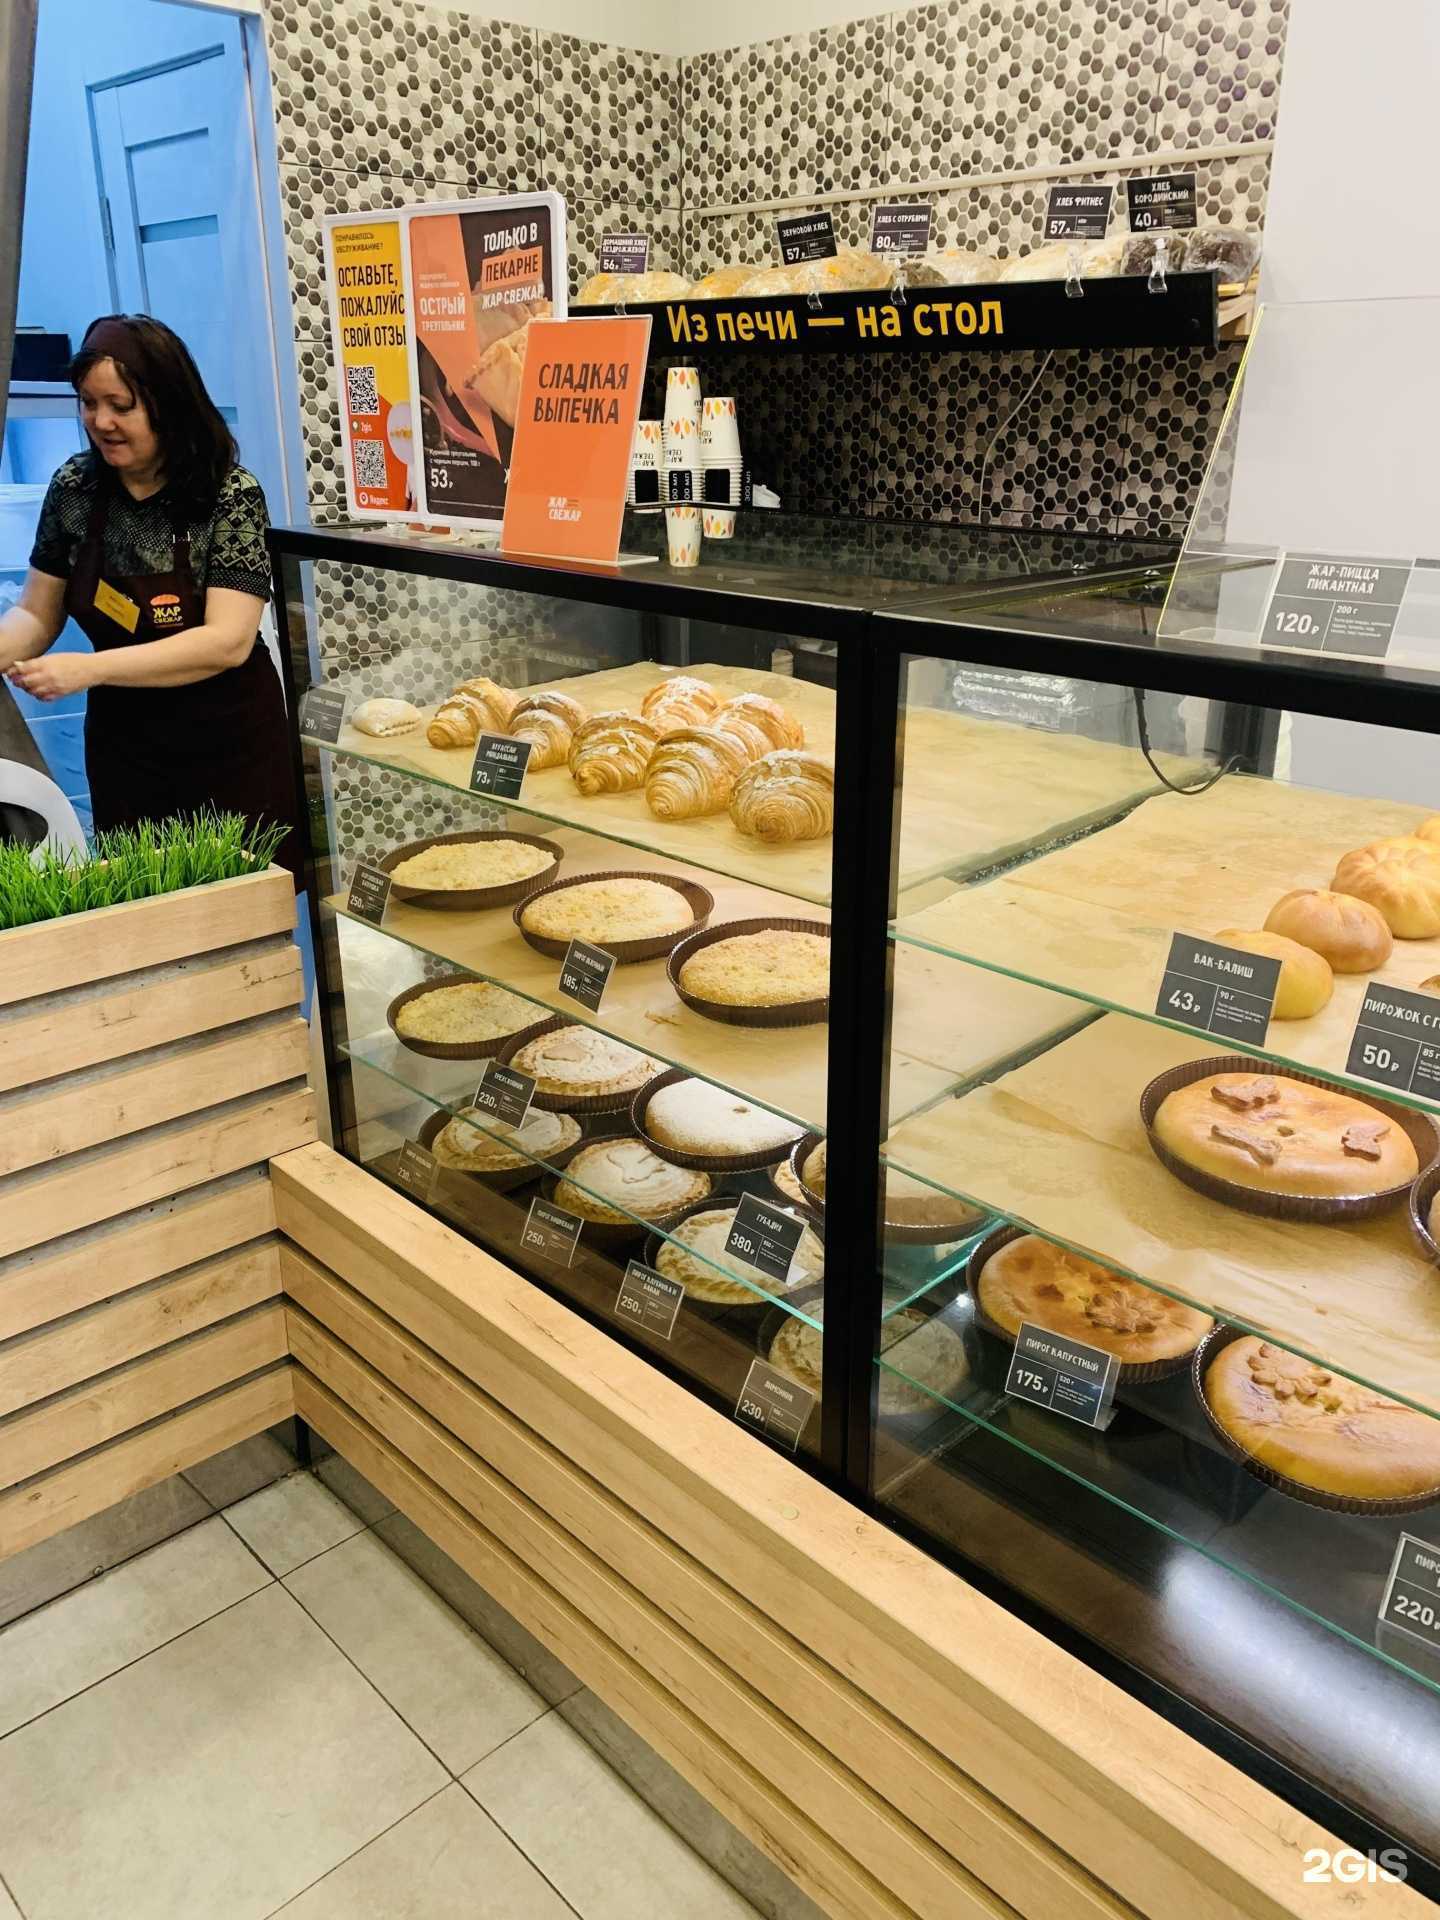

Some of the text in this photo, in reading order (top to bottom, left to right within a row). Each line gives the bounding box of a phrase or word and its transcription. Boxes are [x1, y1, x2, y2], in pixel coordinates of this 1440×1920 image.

[1151, 181, 1171, 192] ХЛЕБ
[1056, 196, 1104, 207] ХЛЕБ ФИТНЕС
[1134, 190, 1189, 204] БОРОДИНСКИЙ
[781, 221, 829, 238] ЗЕРНОВОЙ ХЛЕБ
[877, 215, 893, 224] ХЛЕБ
[483, 222, 538, 253] ТОЛЬКО В
[338, 263, 398, 287] ОСТАВЬТЕ,
[485, 253, 538, 282] ПЕКАРНЕ
[420, 292, 466, 316] ОСТРЫЙ
[481, 283, 545, 310] ЖАР СВЕЖАР
[666, 304, 709, 343] Из
[716, 309, 798, 342] печи
[856, 304, 902, 338] на
[913, 300, 1004, 336] стол
[343, 323, 372, 348] СВОЙ
[538, 363, 630, 393] СЛАДКАЯ
[533, 396, 619, 425] ВЫПЕЧКА
[548, 496, 567, 508] ЖАР
[1308, 564, 1380, 581] ЖАР-ПИЦЦА
[1307, 578, 1375, 594] ПИКАНТНАЯ
[152, 606, 181, 618] ЖАР
[1336, 605, 1352, 615] 200
[1193, 952, 1254, 979] ВАК-БАЛИШ
[1220, 990, 1230, 1000] 90
[1364, 998, 1440, 1029] ПИРОЖОК С Г
[1422, 1048, 1435, 1058] 85
[756, 1213, 783, 1233] ГУБАДИЯ
[1025, 1337, 1099, 1373] ПИРОГ КАПУСТНЫЙ
